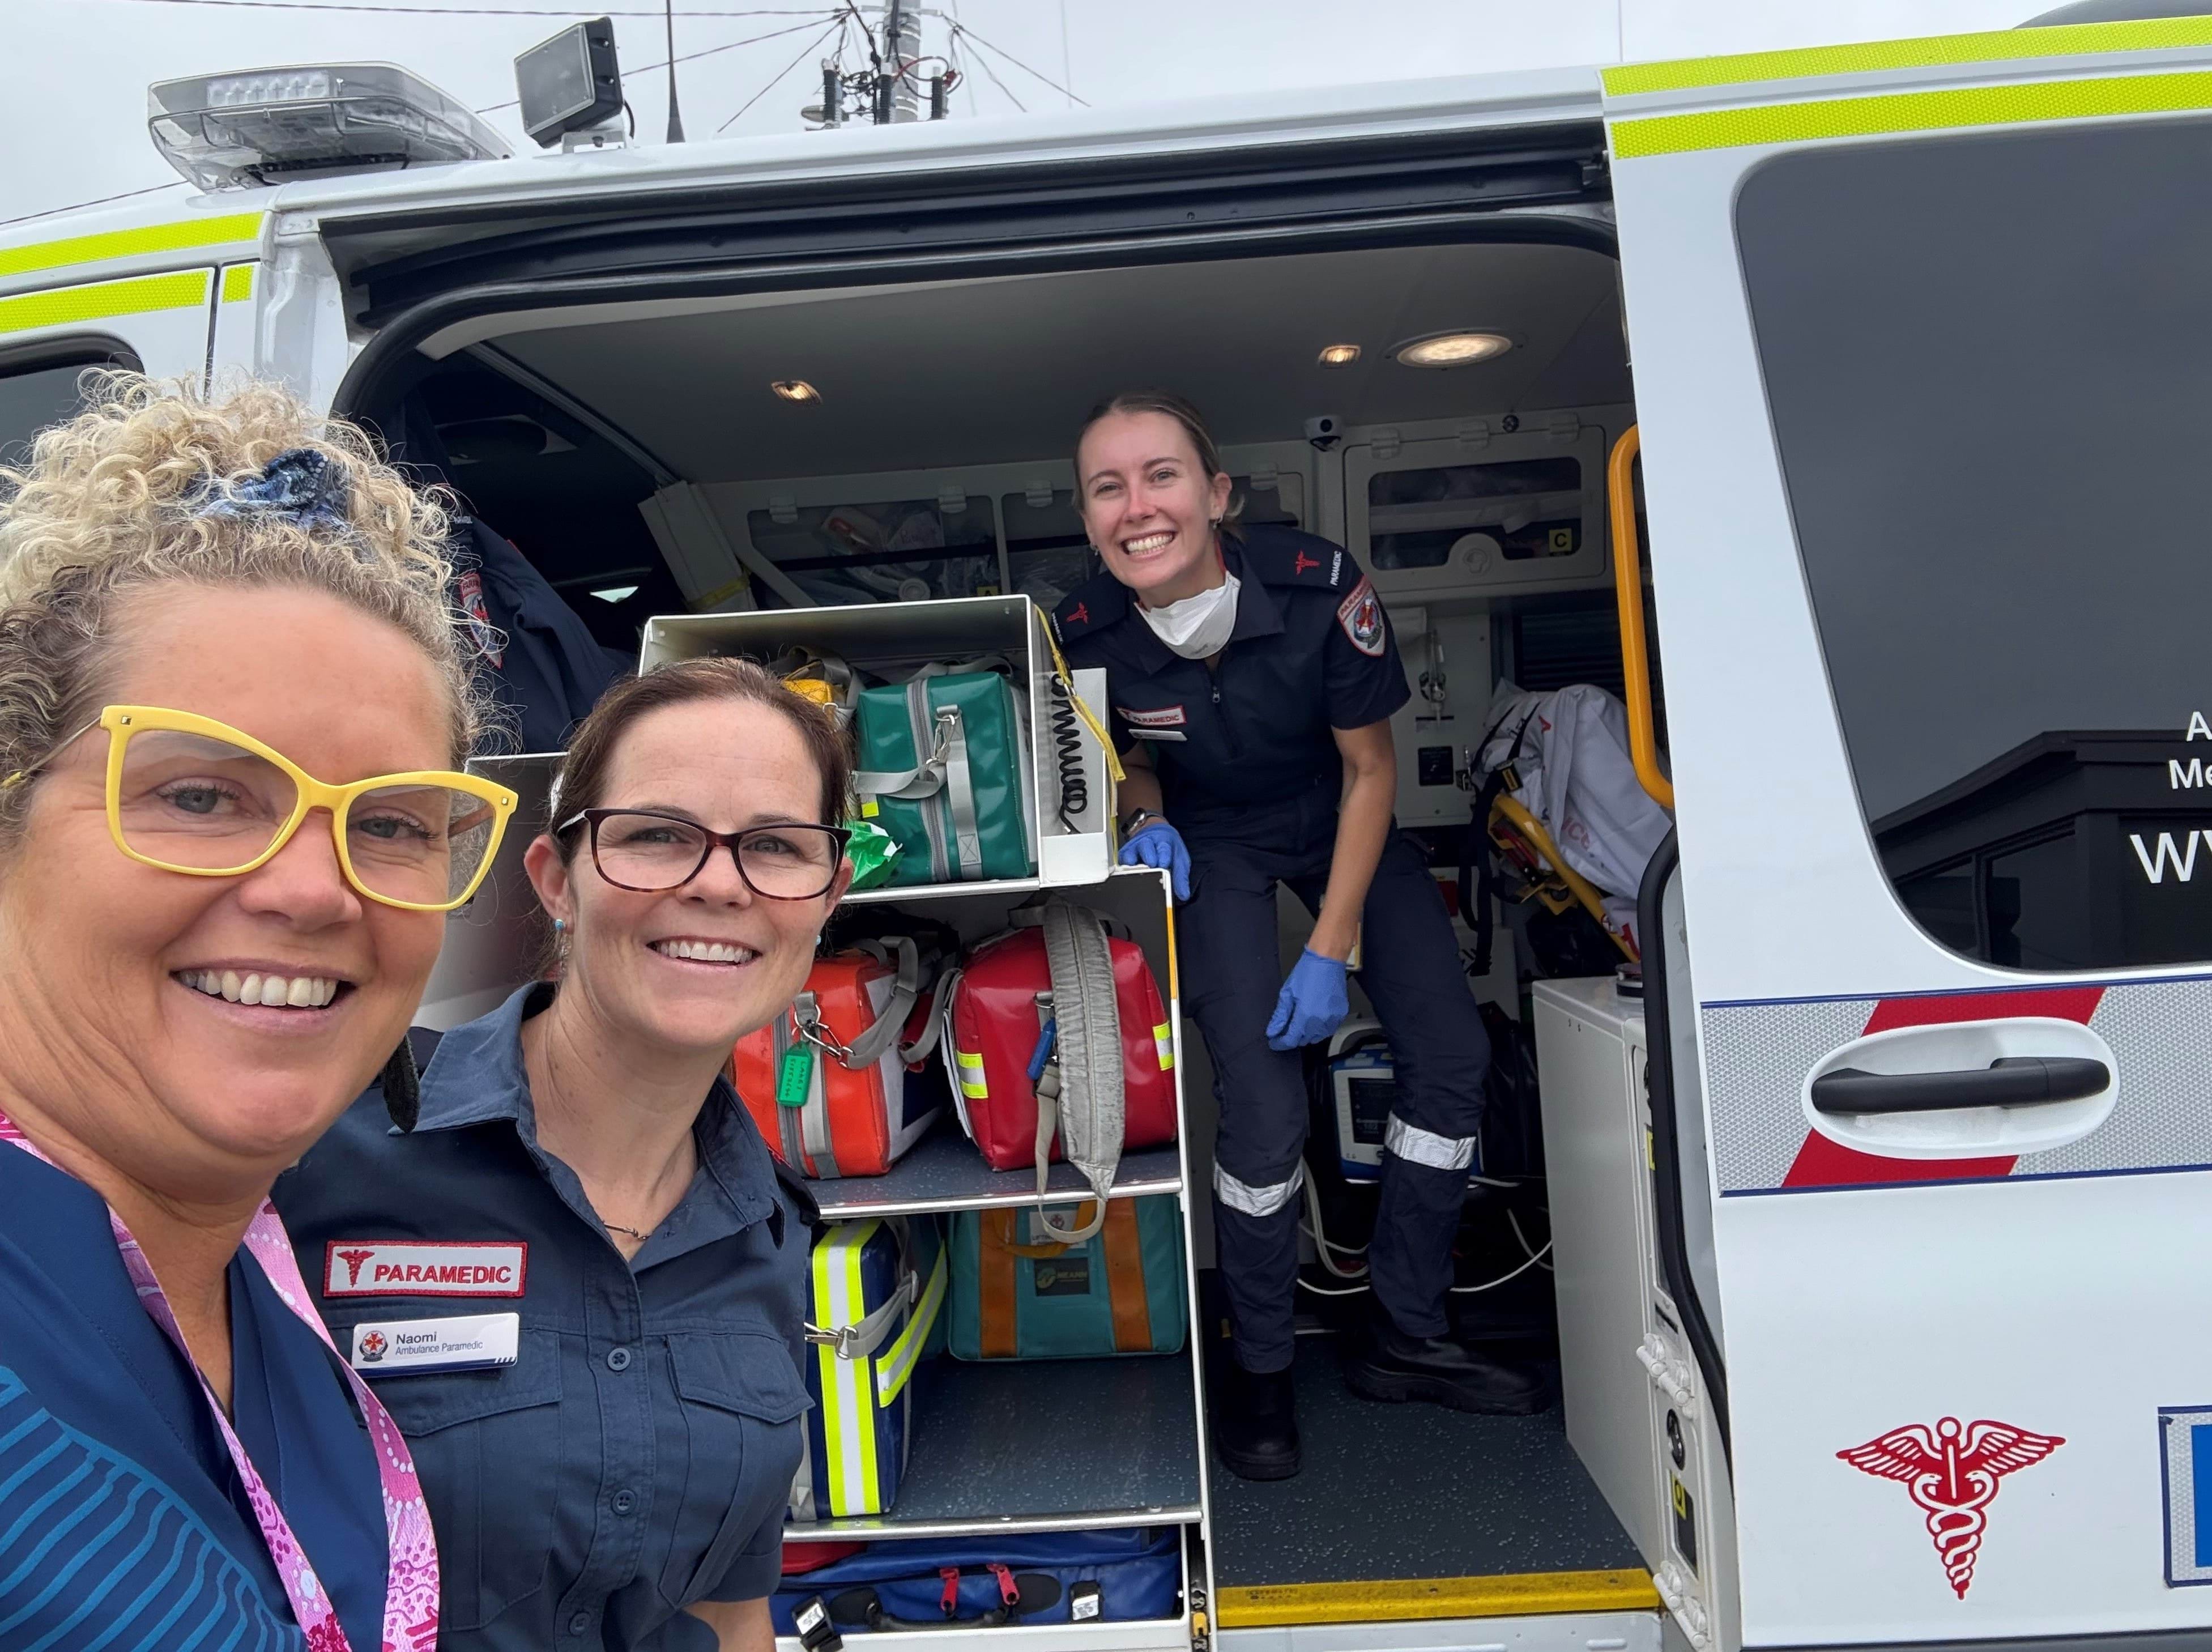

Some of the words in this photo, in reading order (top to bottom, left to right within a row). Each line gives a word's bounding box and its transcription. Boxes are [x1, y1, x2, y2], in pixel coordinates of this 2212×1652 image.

[1555, 534, 1566, 547] C
[1330, 551, 1342, 585] PARAMEDIC
[374, 1264, 511, 1283] PARAMEDIC
[397, 1331, 437, 1344] Naomi
[395, 1345, 440, 1355] Ambulance
[442, 1341, 483, 1352] Paramedic
